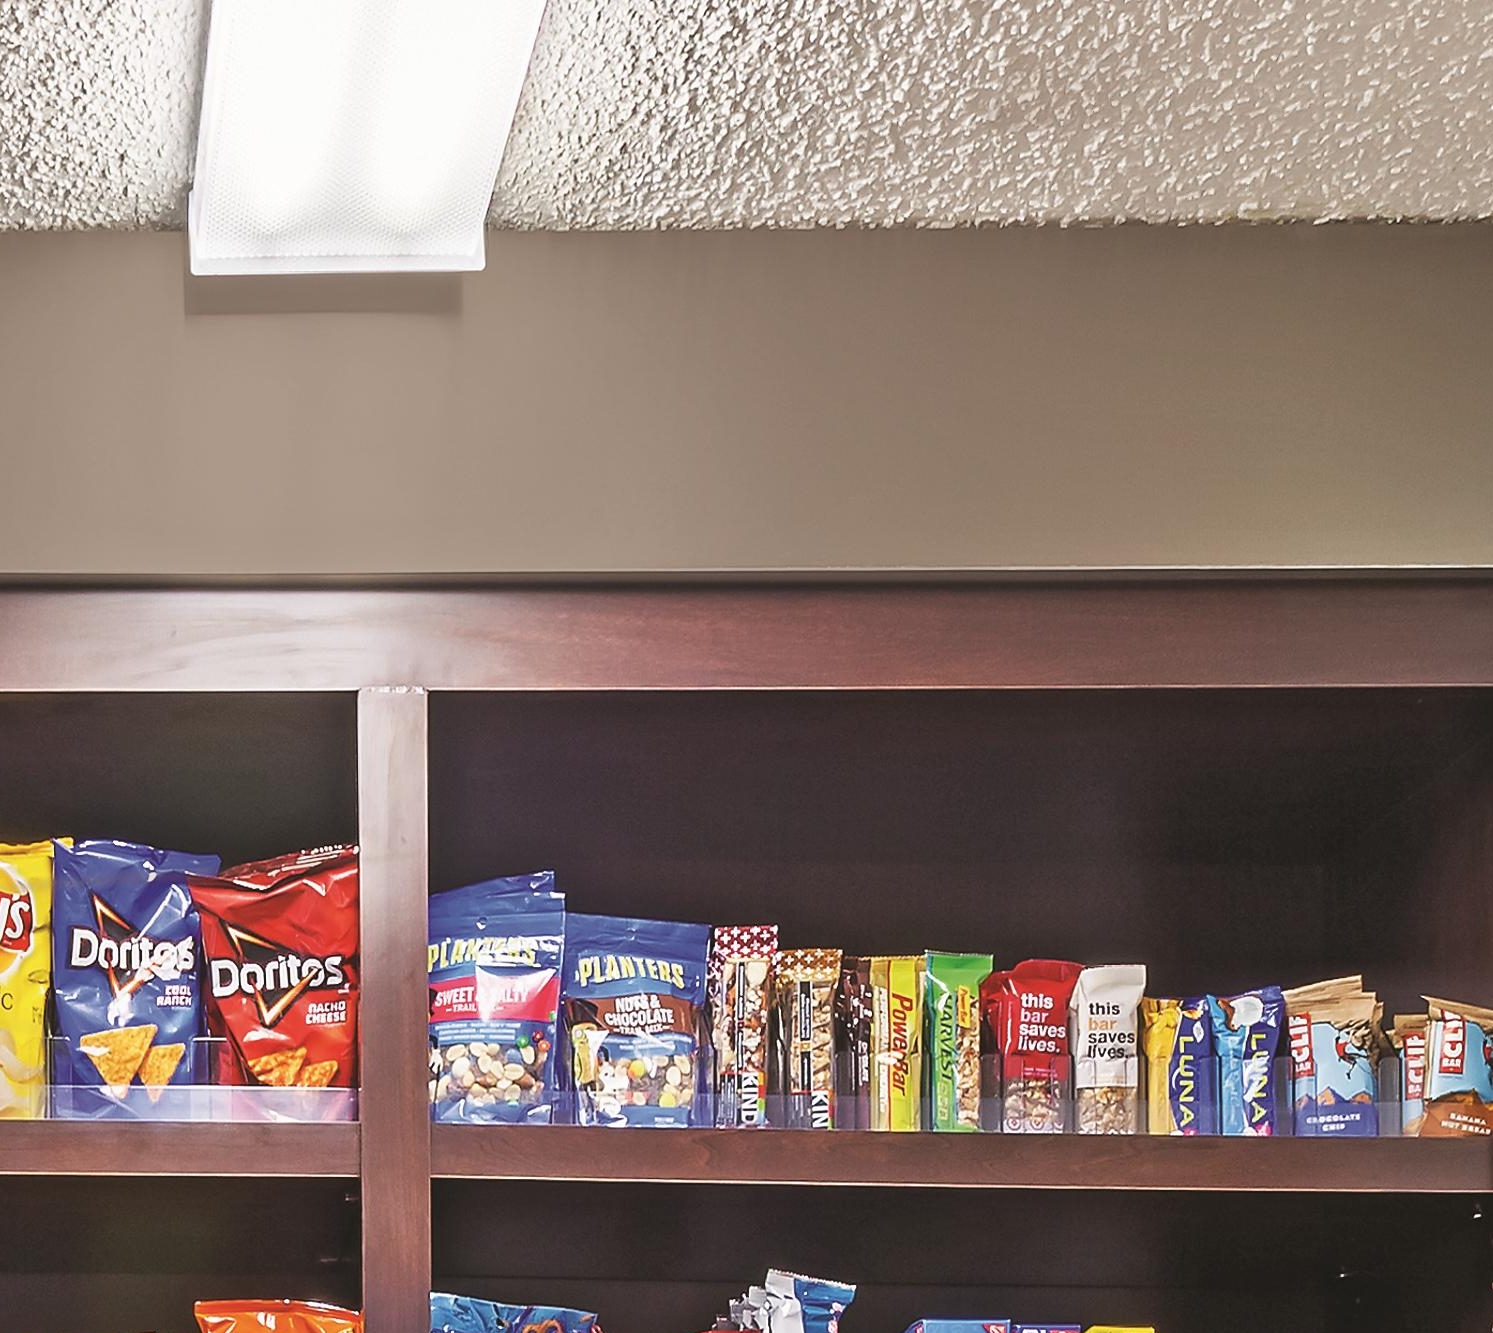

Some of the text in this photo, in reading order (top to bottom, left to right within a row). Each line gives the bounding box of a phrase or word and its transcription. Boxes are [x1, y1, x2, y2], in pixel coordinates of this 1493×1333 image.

[70, 928, 195, 979] Doritos
[213, 954, 343, 998] Doritos
[578, 957, 685, 989] PLANTERS
[1020, 993, 1054, 1010] this
[1089, 1001, 1120, 1017] this
[605, 1010, 674, 1025] CHOCOLATE
[1020, 1009, 1048, 1024] bar
[1089, 1016, 1116, 1031] bar
[1019, 1024, 1065, 1040] saves
[1088, 1031, 1136, 1045] saves
[1018, 1036, 1061, 1055] lives.
[1087, 1044, 1130, 1060] lives.
[1179, 1035, 1195, 1128] LUNA
[1251, 1034, 1267, 1124] LUNA
[742, 1074, 758, 1122] KIND
